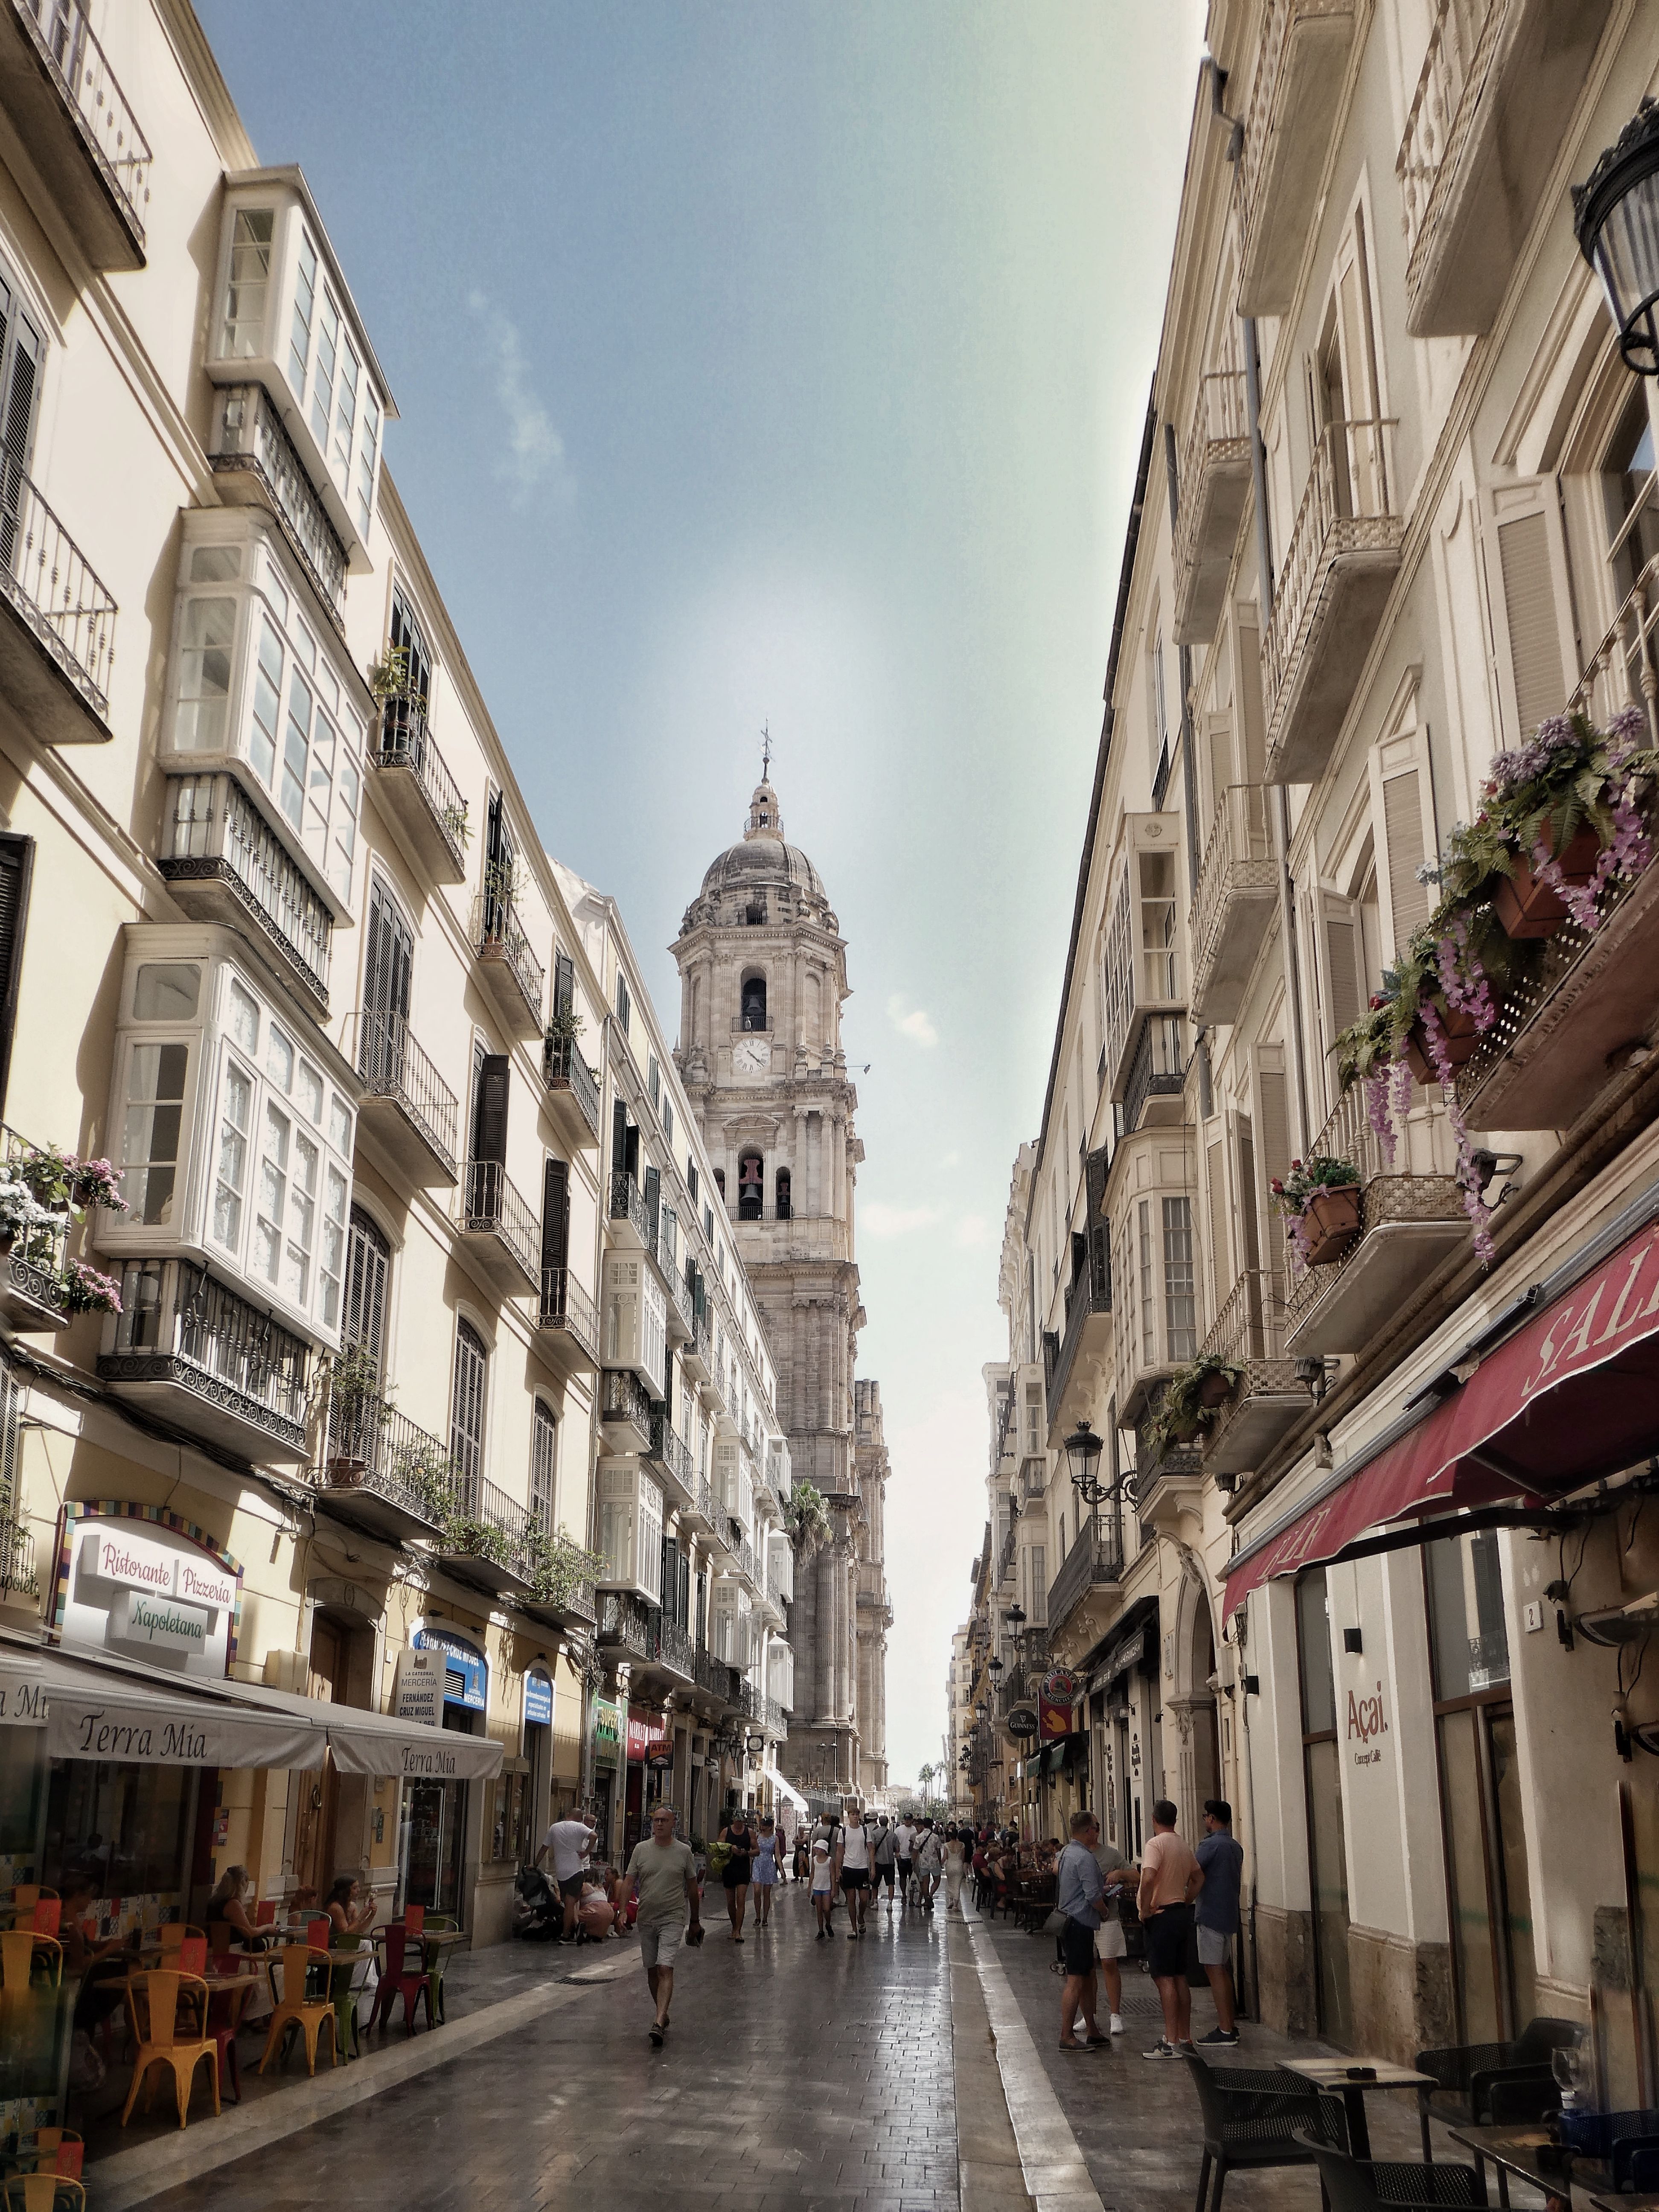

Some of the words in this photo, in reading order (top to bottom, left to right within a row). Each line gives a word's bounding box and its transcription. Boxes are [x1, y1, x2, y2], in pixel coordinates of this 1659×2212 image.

[103, 1542, 171, 1586] Ristorante
[132, 1600, 203, 1640] Napoletana
[1529, 1608, 1534, 1626] 2
[401, 1677, 437, 1686] MERCERÍA
[1045, 1670, 1077, 1684] PAULANER
[403, 1691, 434, 1703] FERNÁNDEZ
[464, 1693, 484, 1707] MERCERÍA
[399, 1706, 413, 1716] CRUZ
[415, 1706, 435, 1716] MIGUEL
[601, 1707, 617, 1729] SUPER
[80, 1710, 152, 1755] Terra
[629, 1719, 646, 1741] MARKET
[402, 1744, 432, 1773] Terra
